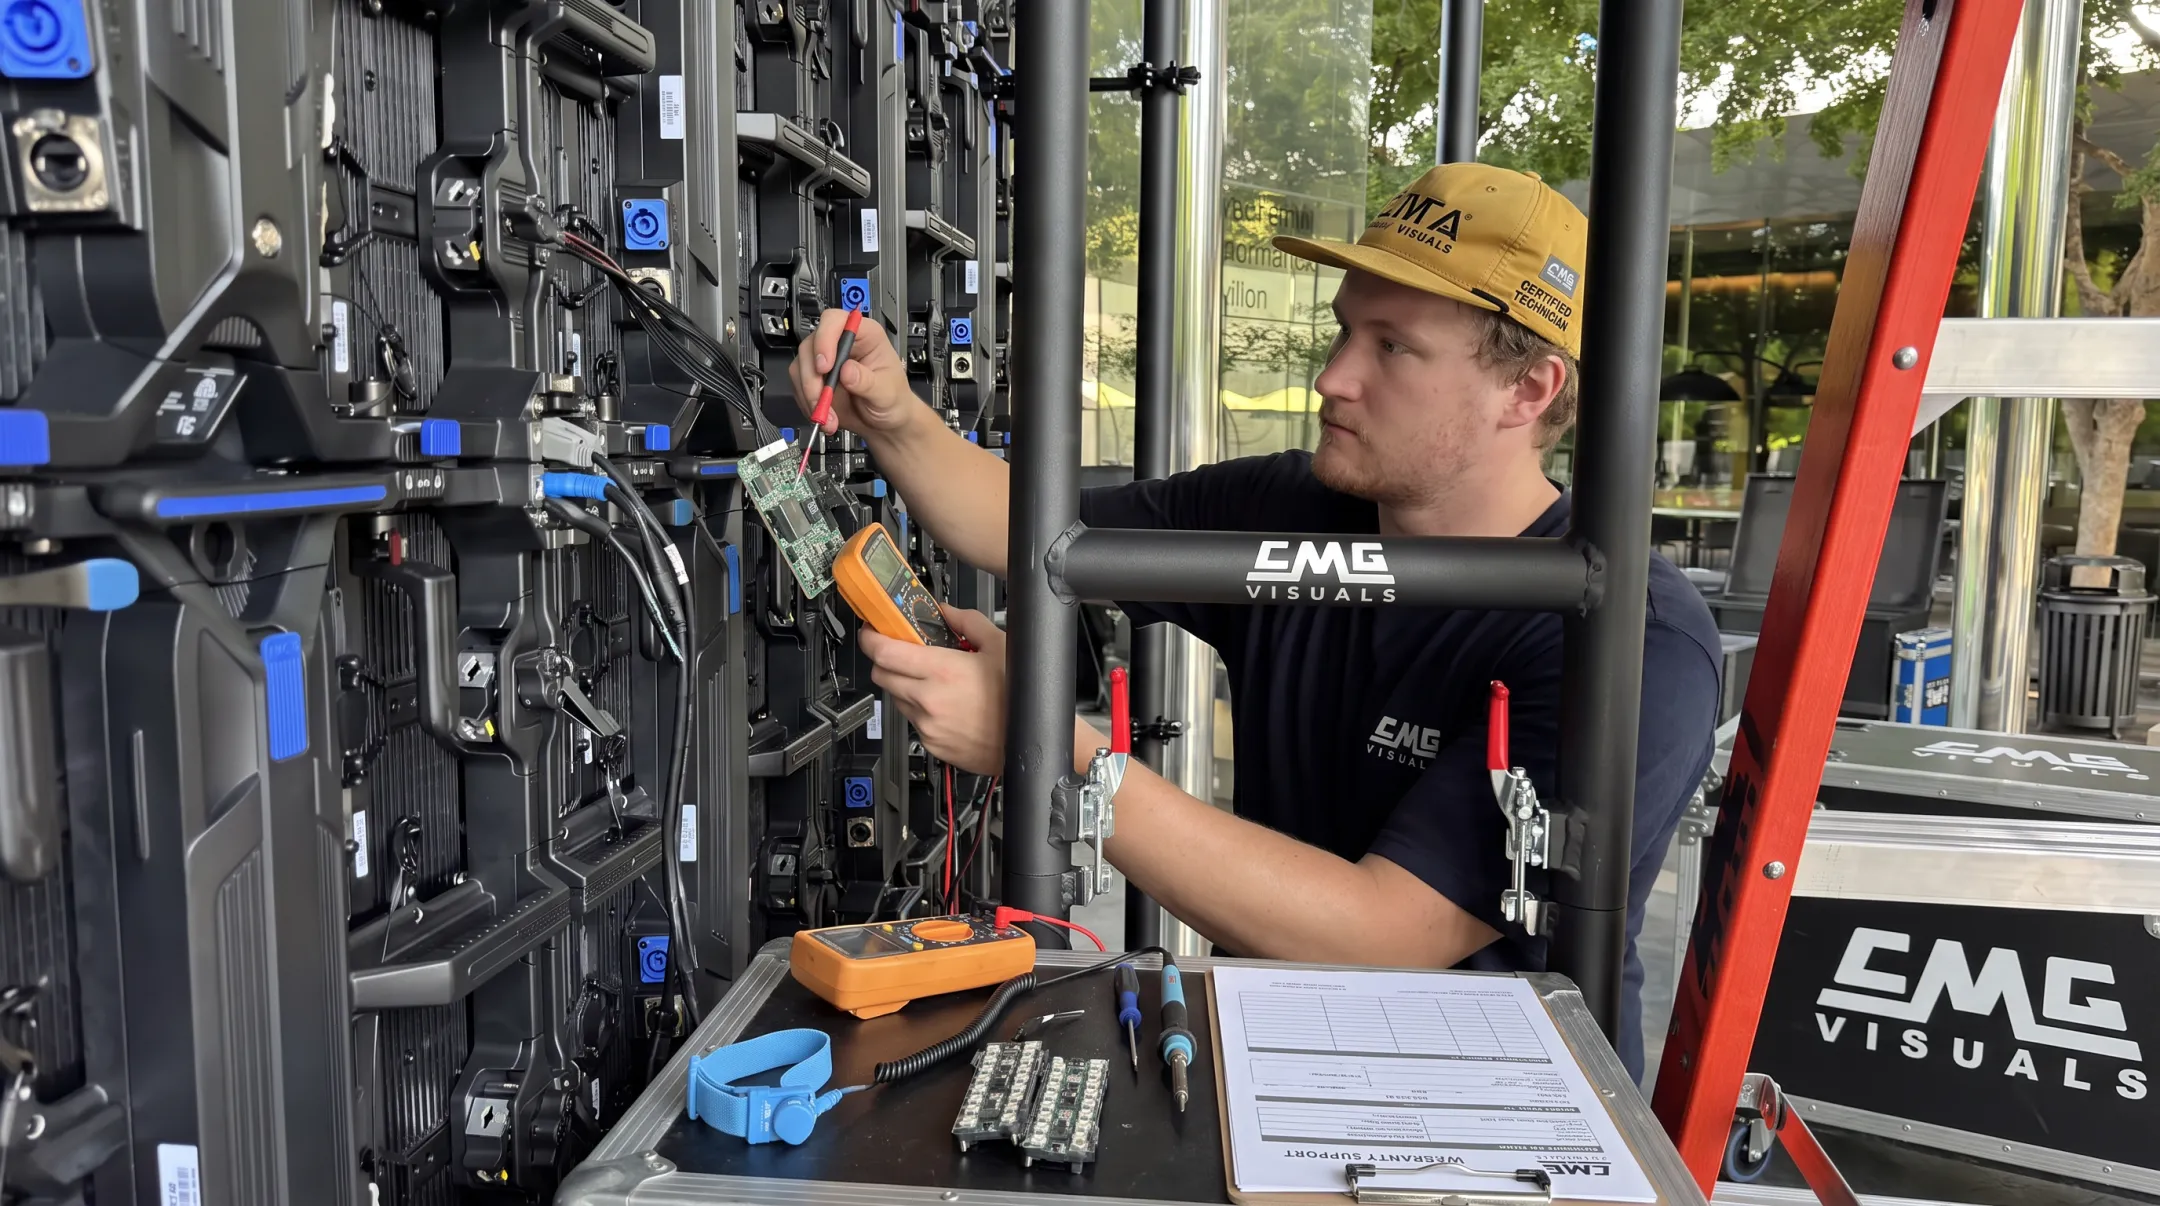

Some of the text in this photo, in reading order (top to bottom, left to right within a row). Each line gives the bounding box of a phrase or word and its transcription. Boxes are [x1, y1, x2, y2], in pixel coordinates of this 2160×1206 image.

[1397, 223, 1453, 255] VISUALS
[1546, 262, 1575, 286] CMG
[1512, 291, 1569, 332] TECHNICIAN
[1520, 280, 1572, 318] CERTIFIED
[1246, 540, 1396, 584] CMG
[1246, 585, 1396, 602] VISUALS
[1369, 716, 1441, 759] CMG
[1912, 750, 2150, 780] VISUALS
[1816, 926, 2143, 1062] CMG
[1814, 1012, 2148, 1100] VISUALS
[1283, 1150, 1362, 1162] SUPPORT
